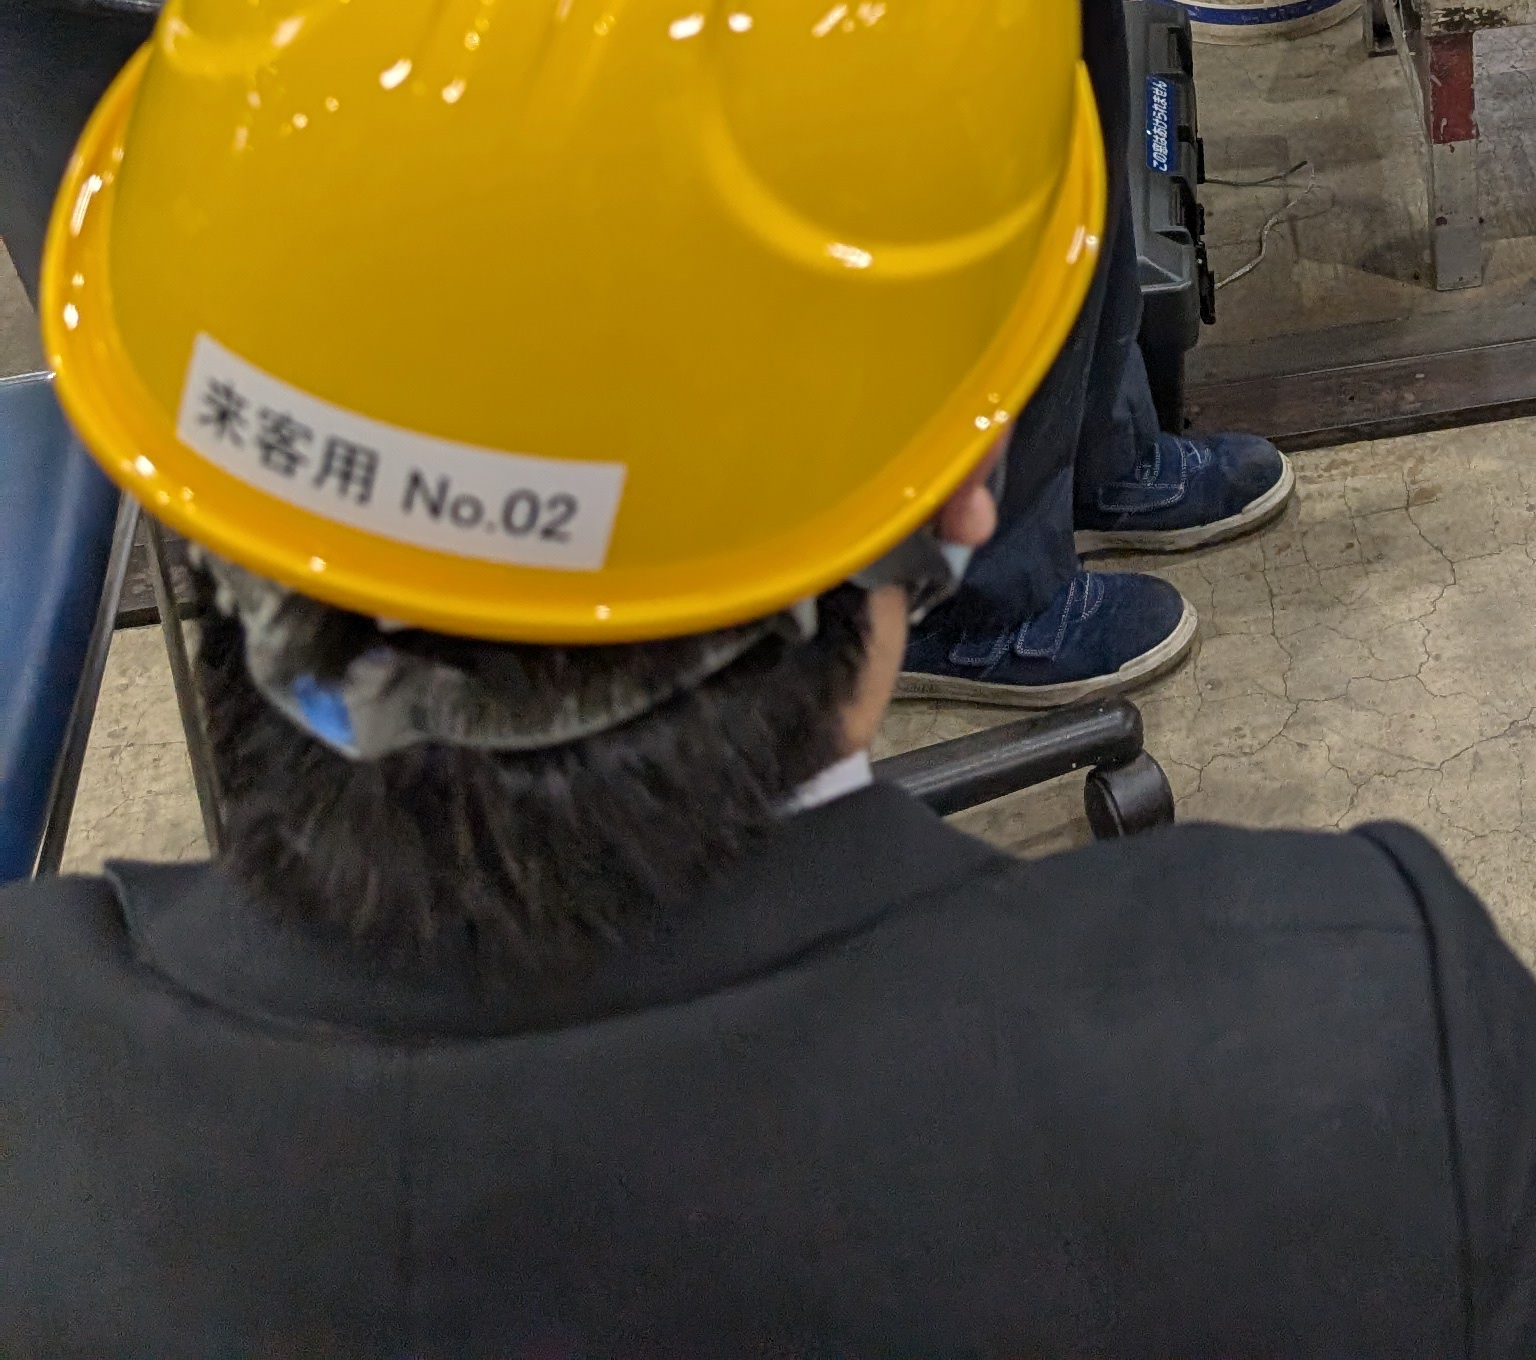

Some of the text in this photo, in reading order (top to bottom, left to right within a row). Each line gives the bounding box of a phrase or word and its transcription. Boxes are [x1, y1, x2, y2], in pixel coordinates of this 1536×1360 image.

[198, 377, 579, 543] 来客用 No.02
